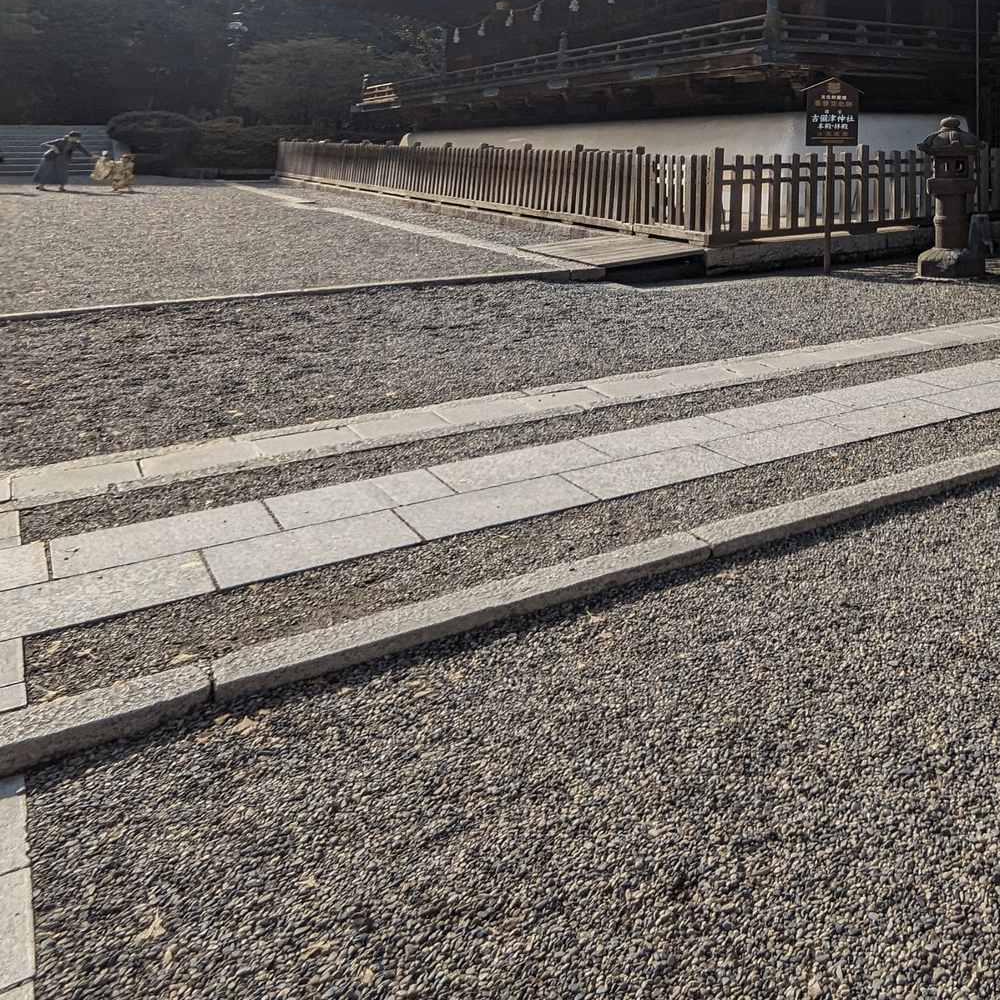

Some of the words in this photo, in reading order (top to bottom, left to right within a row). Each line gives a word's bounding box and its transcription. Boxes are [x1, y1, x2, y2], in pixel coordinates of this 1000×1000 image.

[811, 114, 855, 123] 吉備津神社
